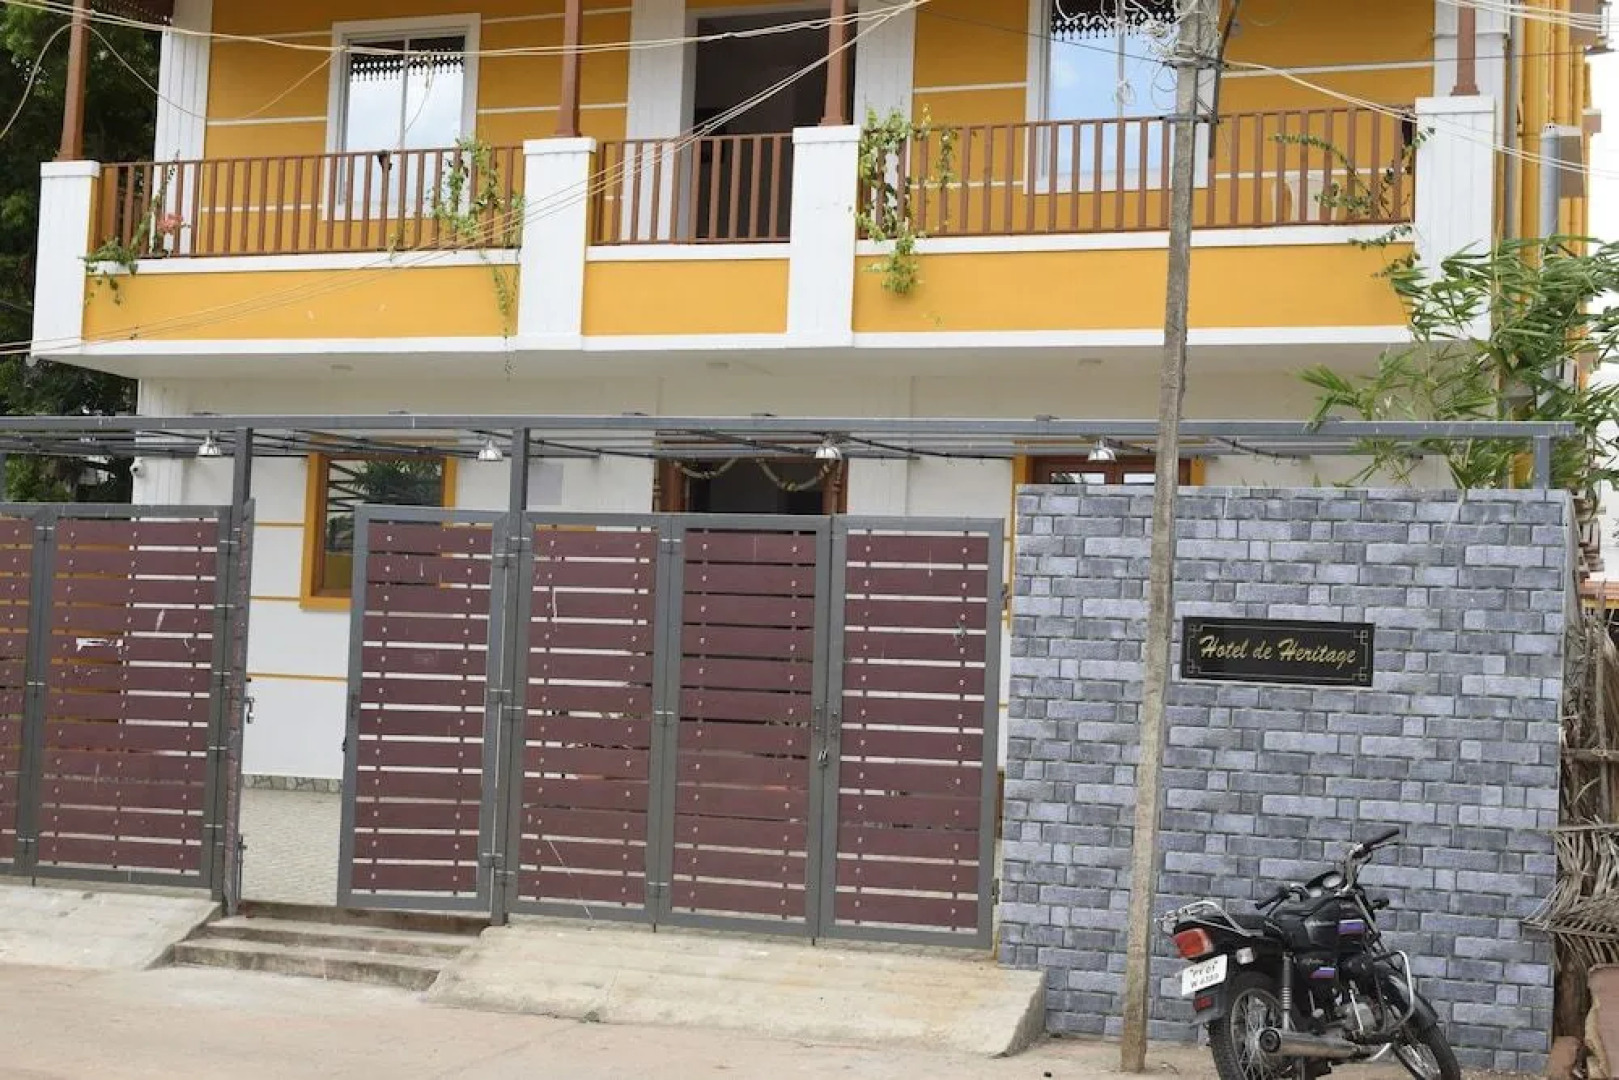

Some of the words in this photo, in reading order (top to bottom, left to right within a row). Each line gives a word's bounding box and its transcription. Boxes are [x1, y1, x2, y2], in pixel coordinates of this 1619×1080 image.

[1199, 635, 1249, 658] Hotel
[1253, 641, 1272, 660] de
[1277, 638, 1357, 669] Heritage
